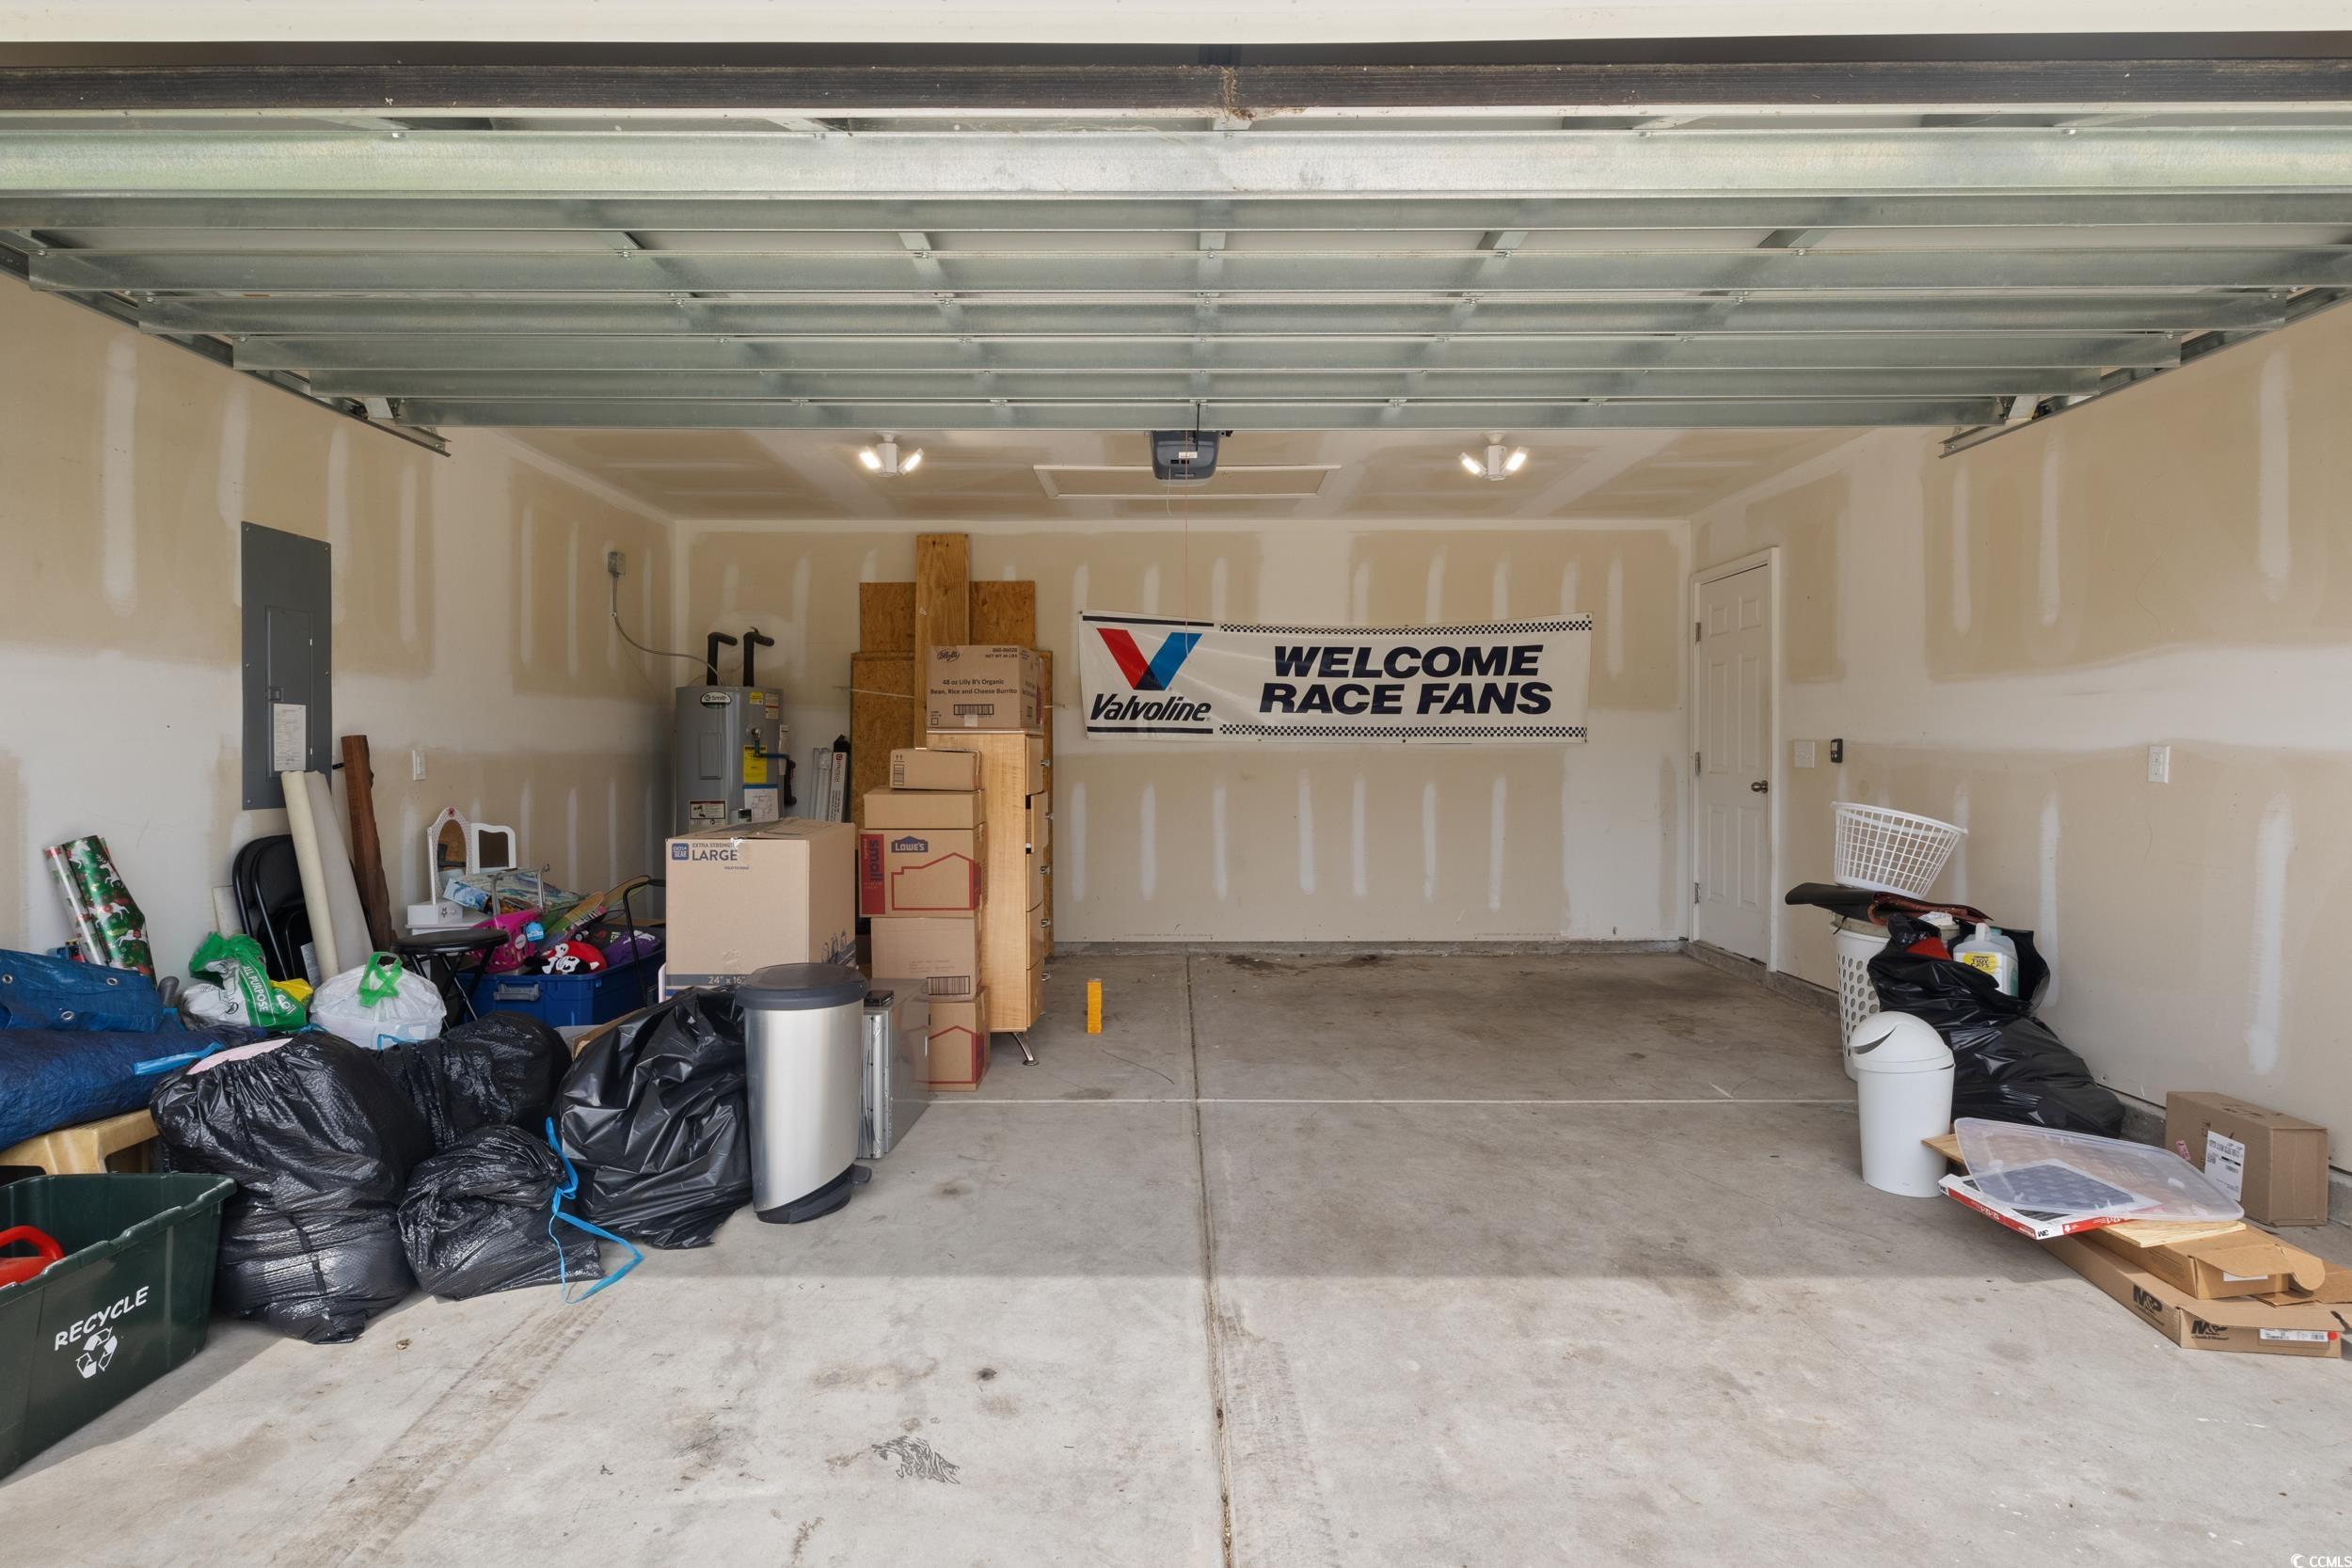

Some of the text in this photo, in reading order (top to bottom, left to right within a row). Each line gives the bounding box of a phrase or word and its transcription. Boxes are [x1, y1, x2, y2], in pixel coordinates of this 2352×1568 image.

[1275, 644, 1544, 678] WELCOME
[1089, 692, 1212, 722] Valvoline
[1259, 682, 1553, 716] RACE FANS
[691, 849, 738, 862] LARGE
[895, 842, 925, 851] LOWE'S
[249, 975, 269, 1012] PURPOSE
[55, 1285, 150, 1352] RECYCLE
